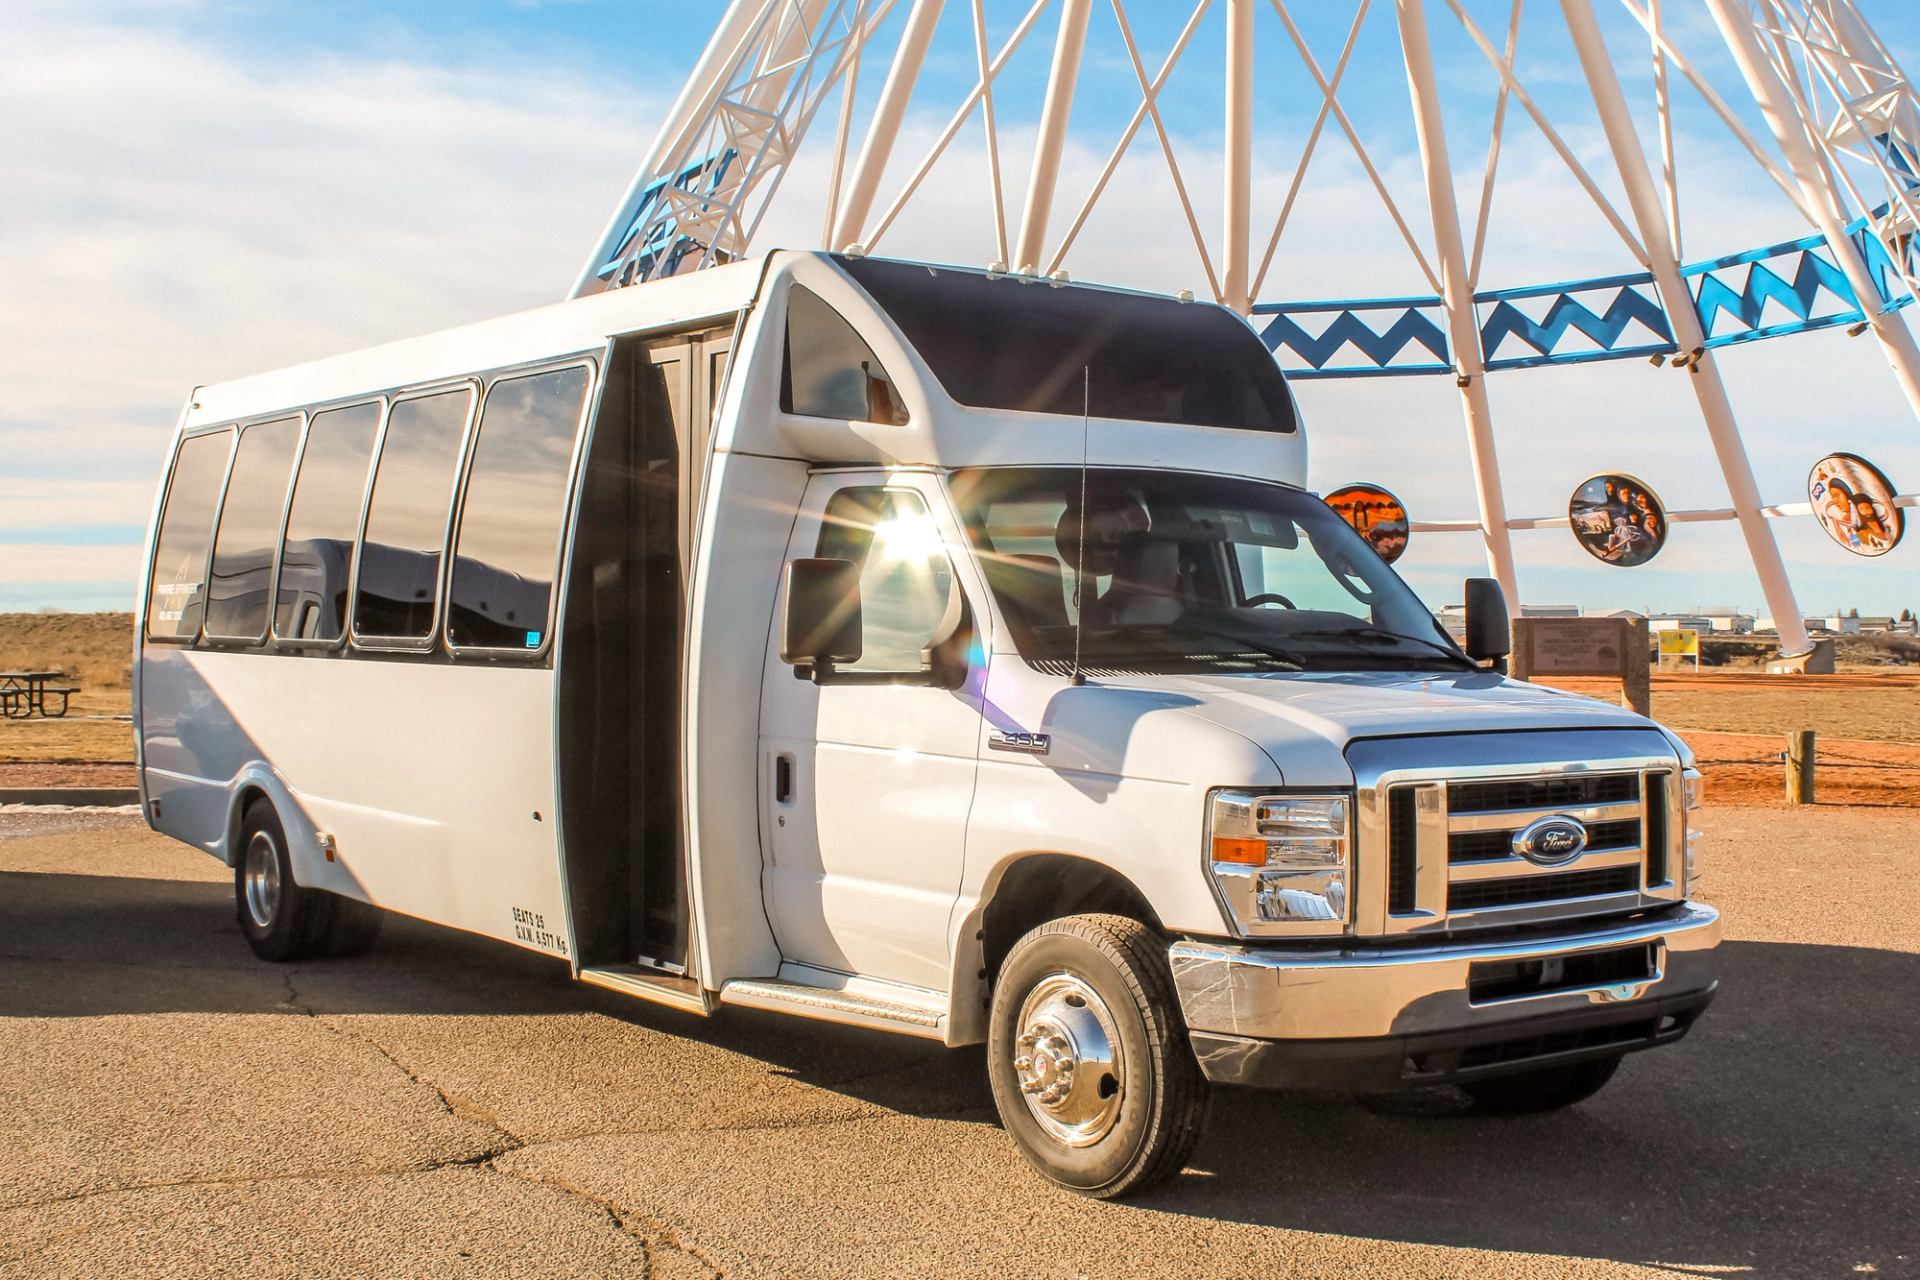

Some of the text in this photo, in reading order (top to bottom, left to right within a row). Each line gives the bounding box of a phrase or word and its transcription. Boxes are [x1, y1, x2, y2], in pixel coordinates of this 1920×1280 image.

[1543, 831, 1574, 849] Ford
[512, 906, 545, 929] SEATS 25
